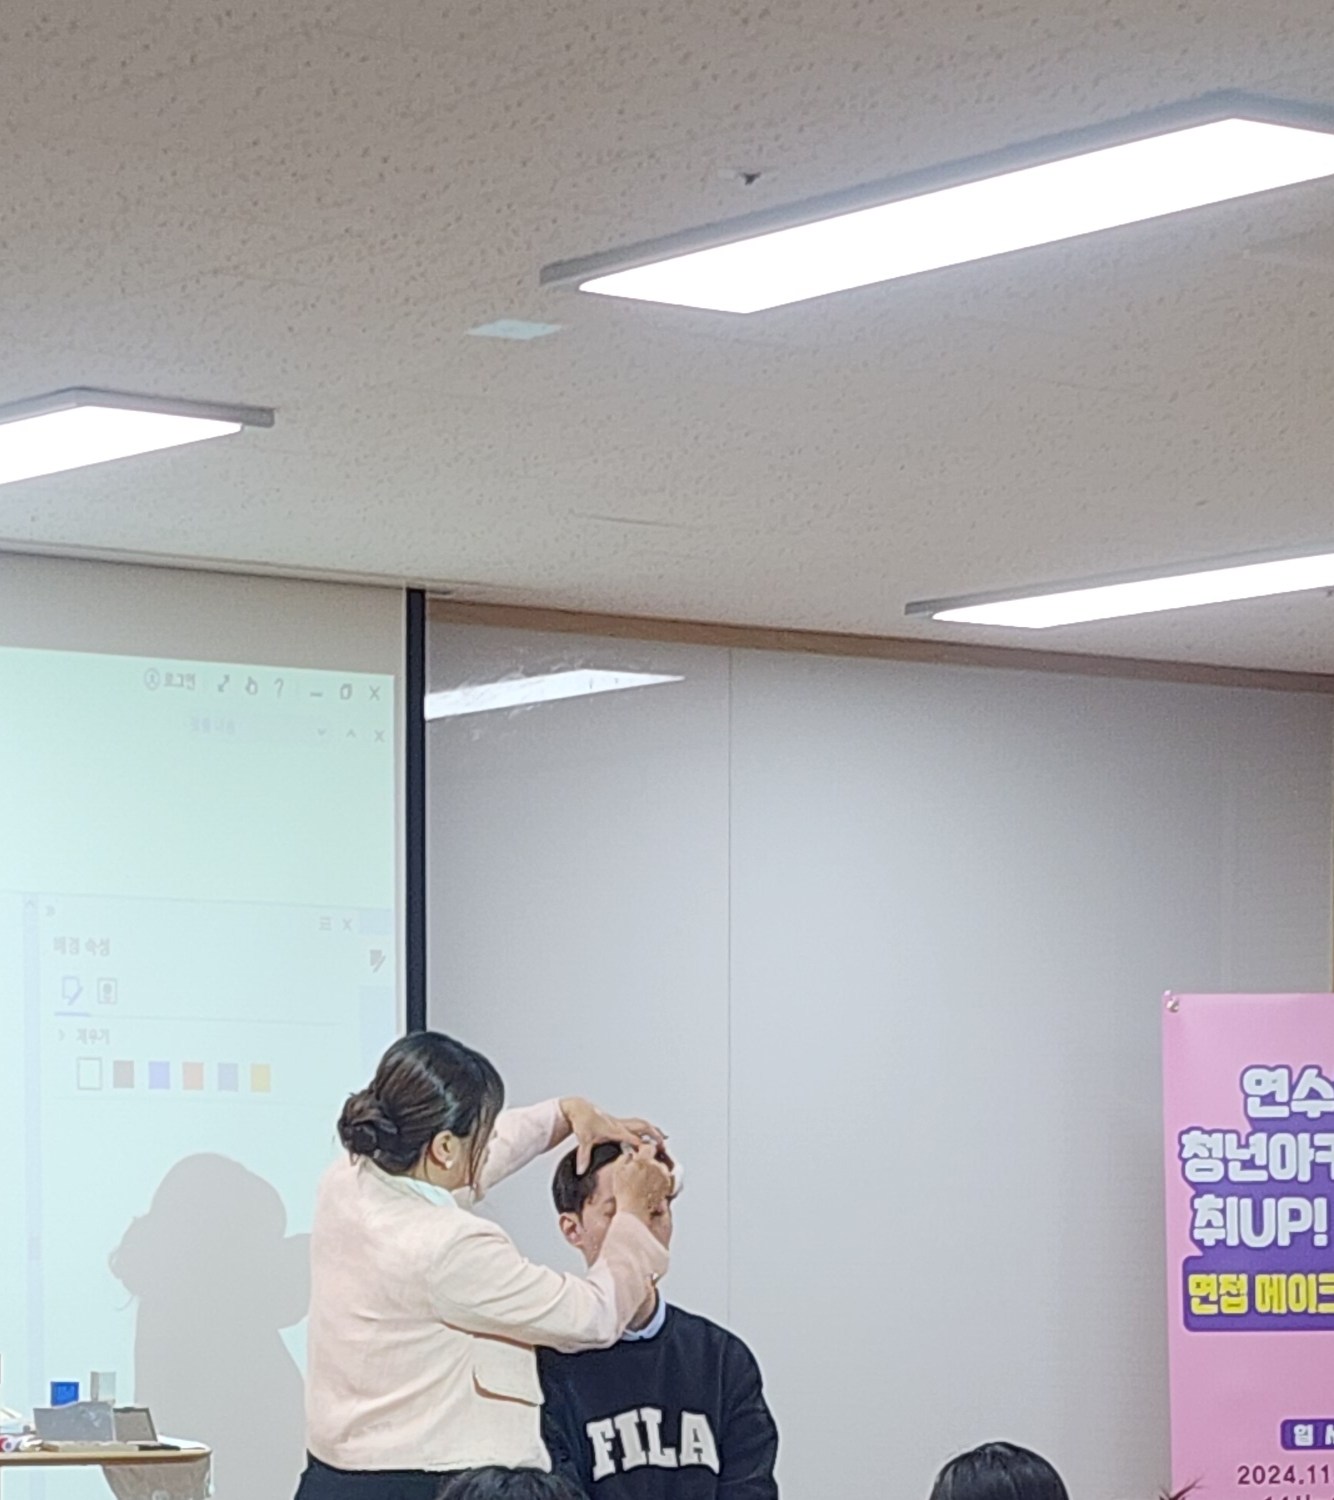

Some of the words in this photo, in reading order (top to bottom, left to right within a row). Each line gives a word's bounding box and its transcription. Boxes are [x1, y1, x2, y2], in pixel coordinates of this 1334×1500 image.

[1193, 1194, 1328, 1247] 취UP!
[1188, 1273, 1248, 1315] 면접
[586, 1407, 720, 1482] FILA
[1293, 1424, 1314, 1447] 일
